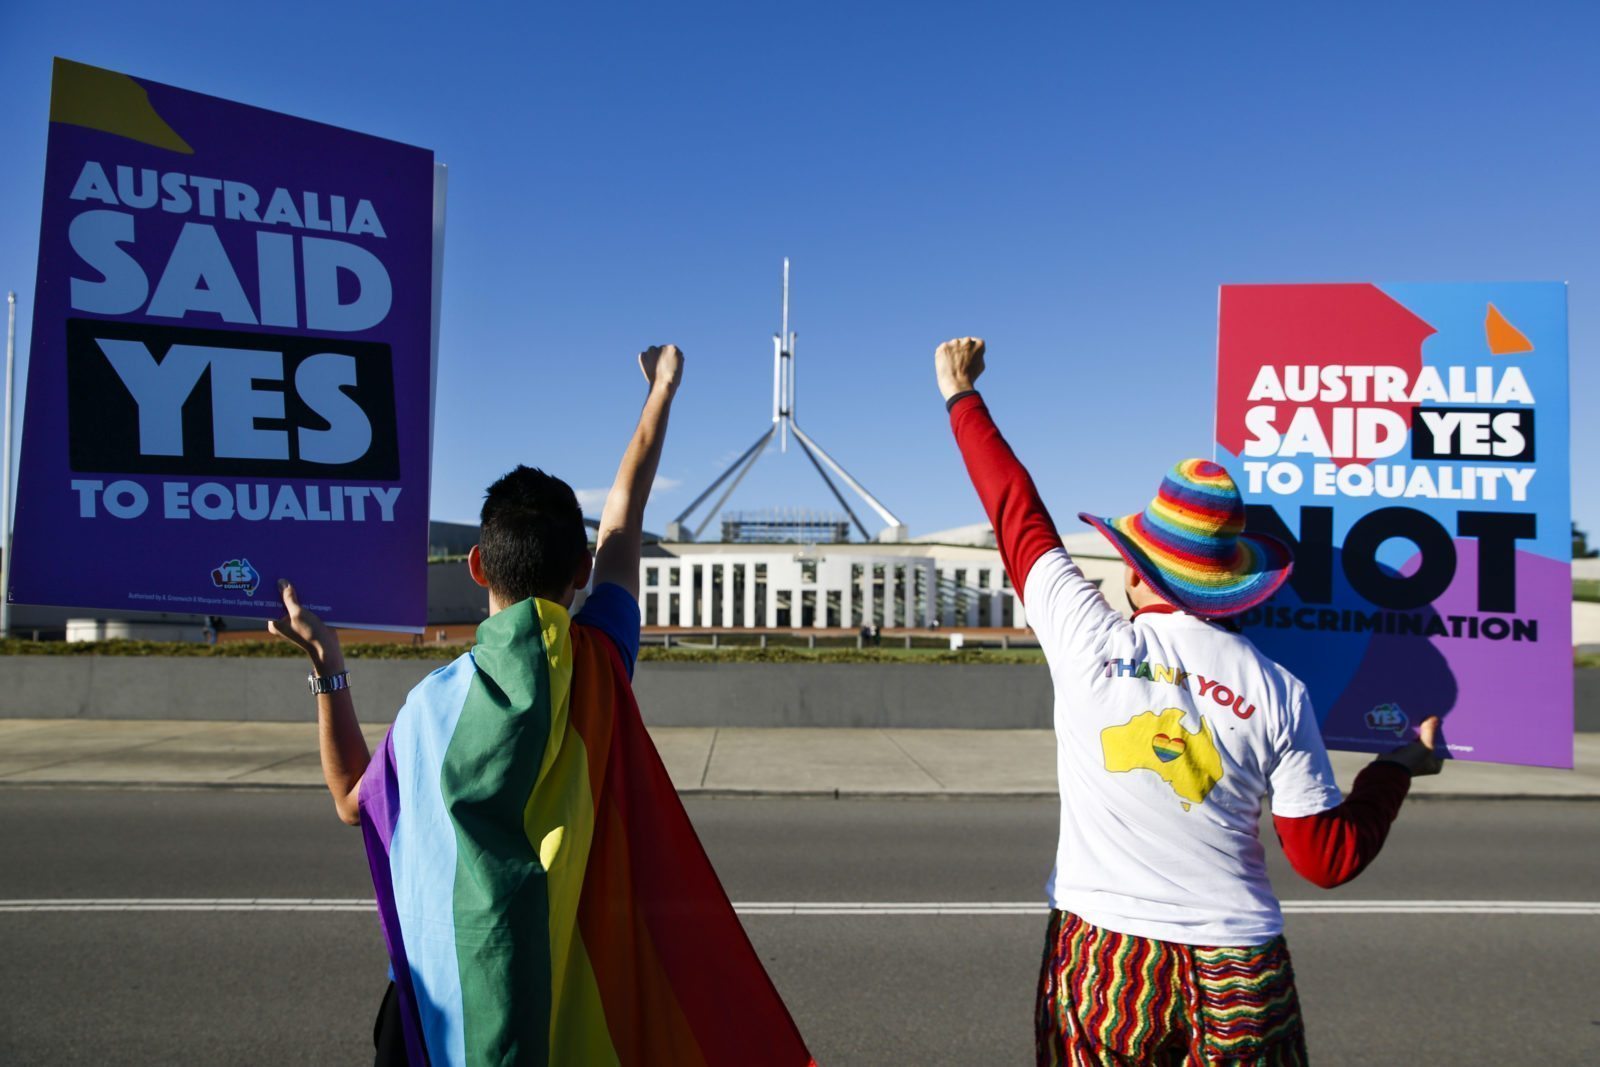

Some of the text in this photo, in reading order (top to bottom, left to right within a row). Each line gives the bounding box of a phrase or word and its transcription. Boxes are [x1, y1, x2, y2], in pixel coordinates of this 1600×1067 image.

[69, 160, 387, 238] AUSTRALIA
[68, 209, 393, 332] SAID
[94, 337, 372, 465] YES
[1247, 364, 1536, 405] AUSTRALIA
[1244, 405, 1526, 459] SAID YES
[71, 479, 402, 522] TO EQUALITY
[1243, 461, 1537, 501] TO EQUALITY
[220, 566, 252, 582] YES
[1243, 503, 1537, 614] NOT
[128, 592, 154, 600] Authorised
[155, 593, 161, 601] by
[237, 599, 253, 607] Sydney
[1241, 605, 1538, 642] DISCRIMINATION
[1104, 657, 1256, 720] THANK YOU
[1372, 710, 1402, 725] YES
